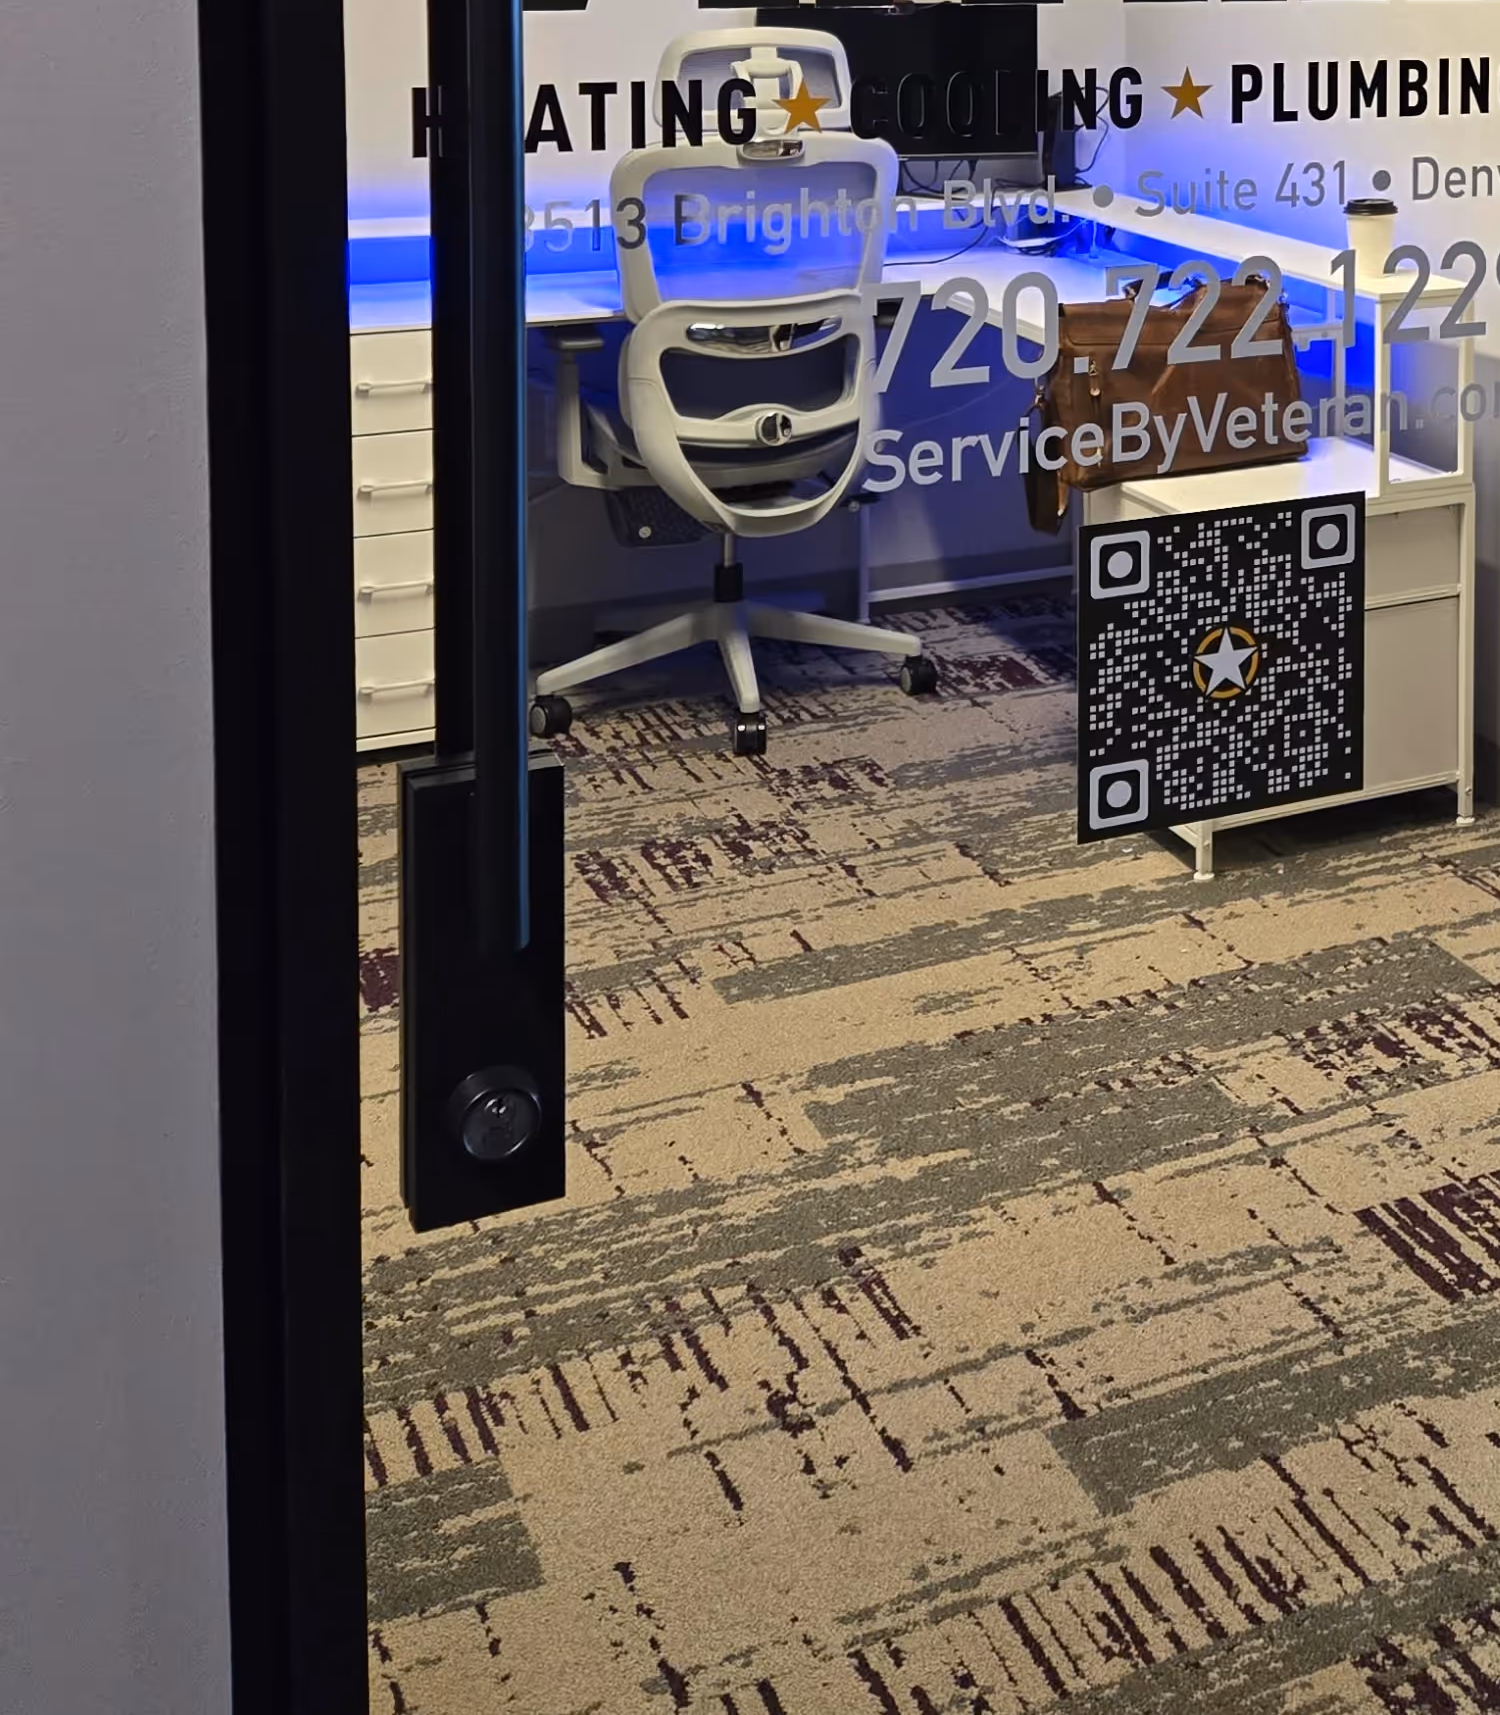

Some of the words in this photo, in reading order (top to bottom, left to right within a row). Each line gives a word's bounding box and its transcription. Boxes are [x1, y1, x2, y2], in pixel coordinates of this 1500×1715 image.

[411, 77, 758, 159] HATING
[850, 66, 1143, 139] COOLING
[674, 187, 918, 256] Brighton
[943, 174, 1071, 230] Blvd.
[1133, 168, 1258, 219] Suite
[1275, 160, 1348, 207] 431
